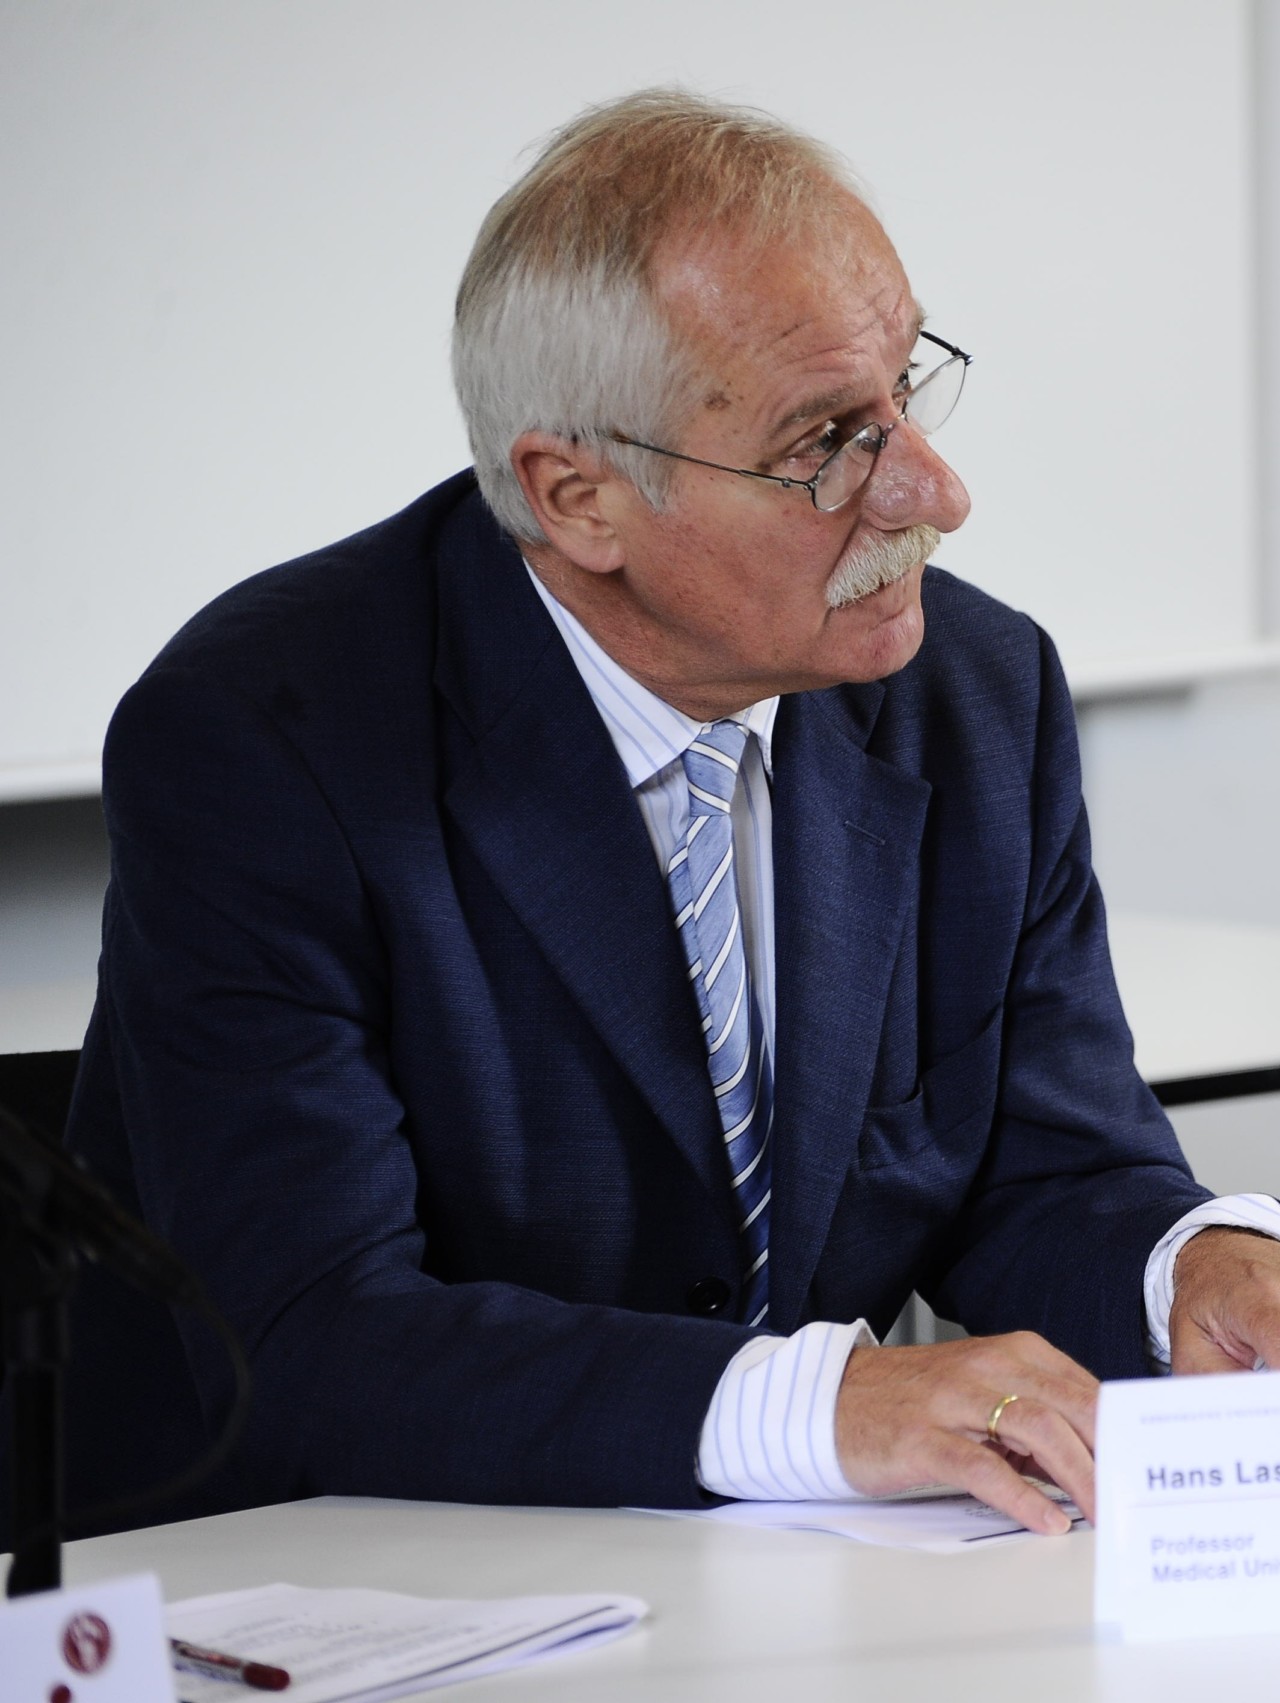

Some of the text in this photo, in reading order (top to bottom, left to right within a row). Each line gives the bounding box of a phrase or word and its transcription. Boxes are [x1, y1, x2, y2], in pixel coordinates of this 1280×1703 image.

[1147, 1466, 1223, 1490] Hans
[1150, 1534, 1255, 1557] Professor
[1151, 1559, 1237, 1583] Medical
